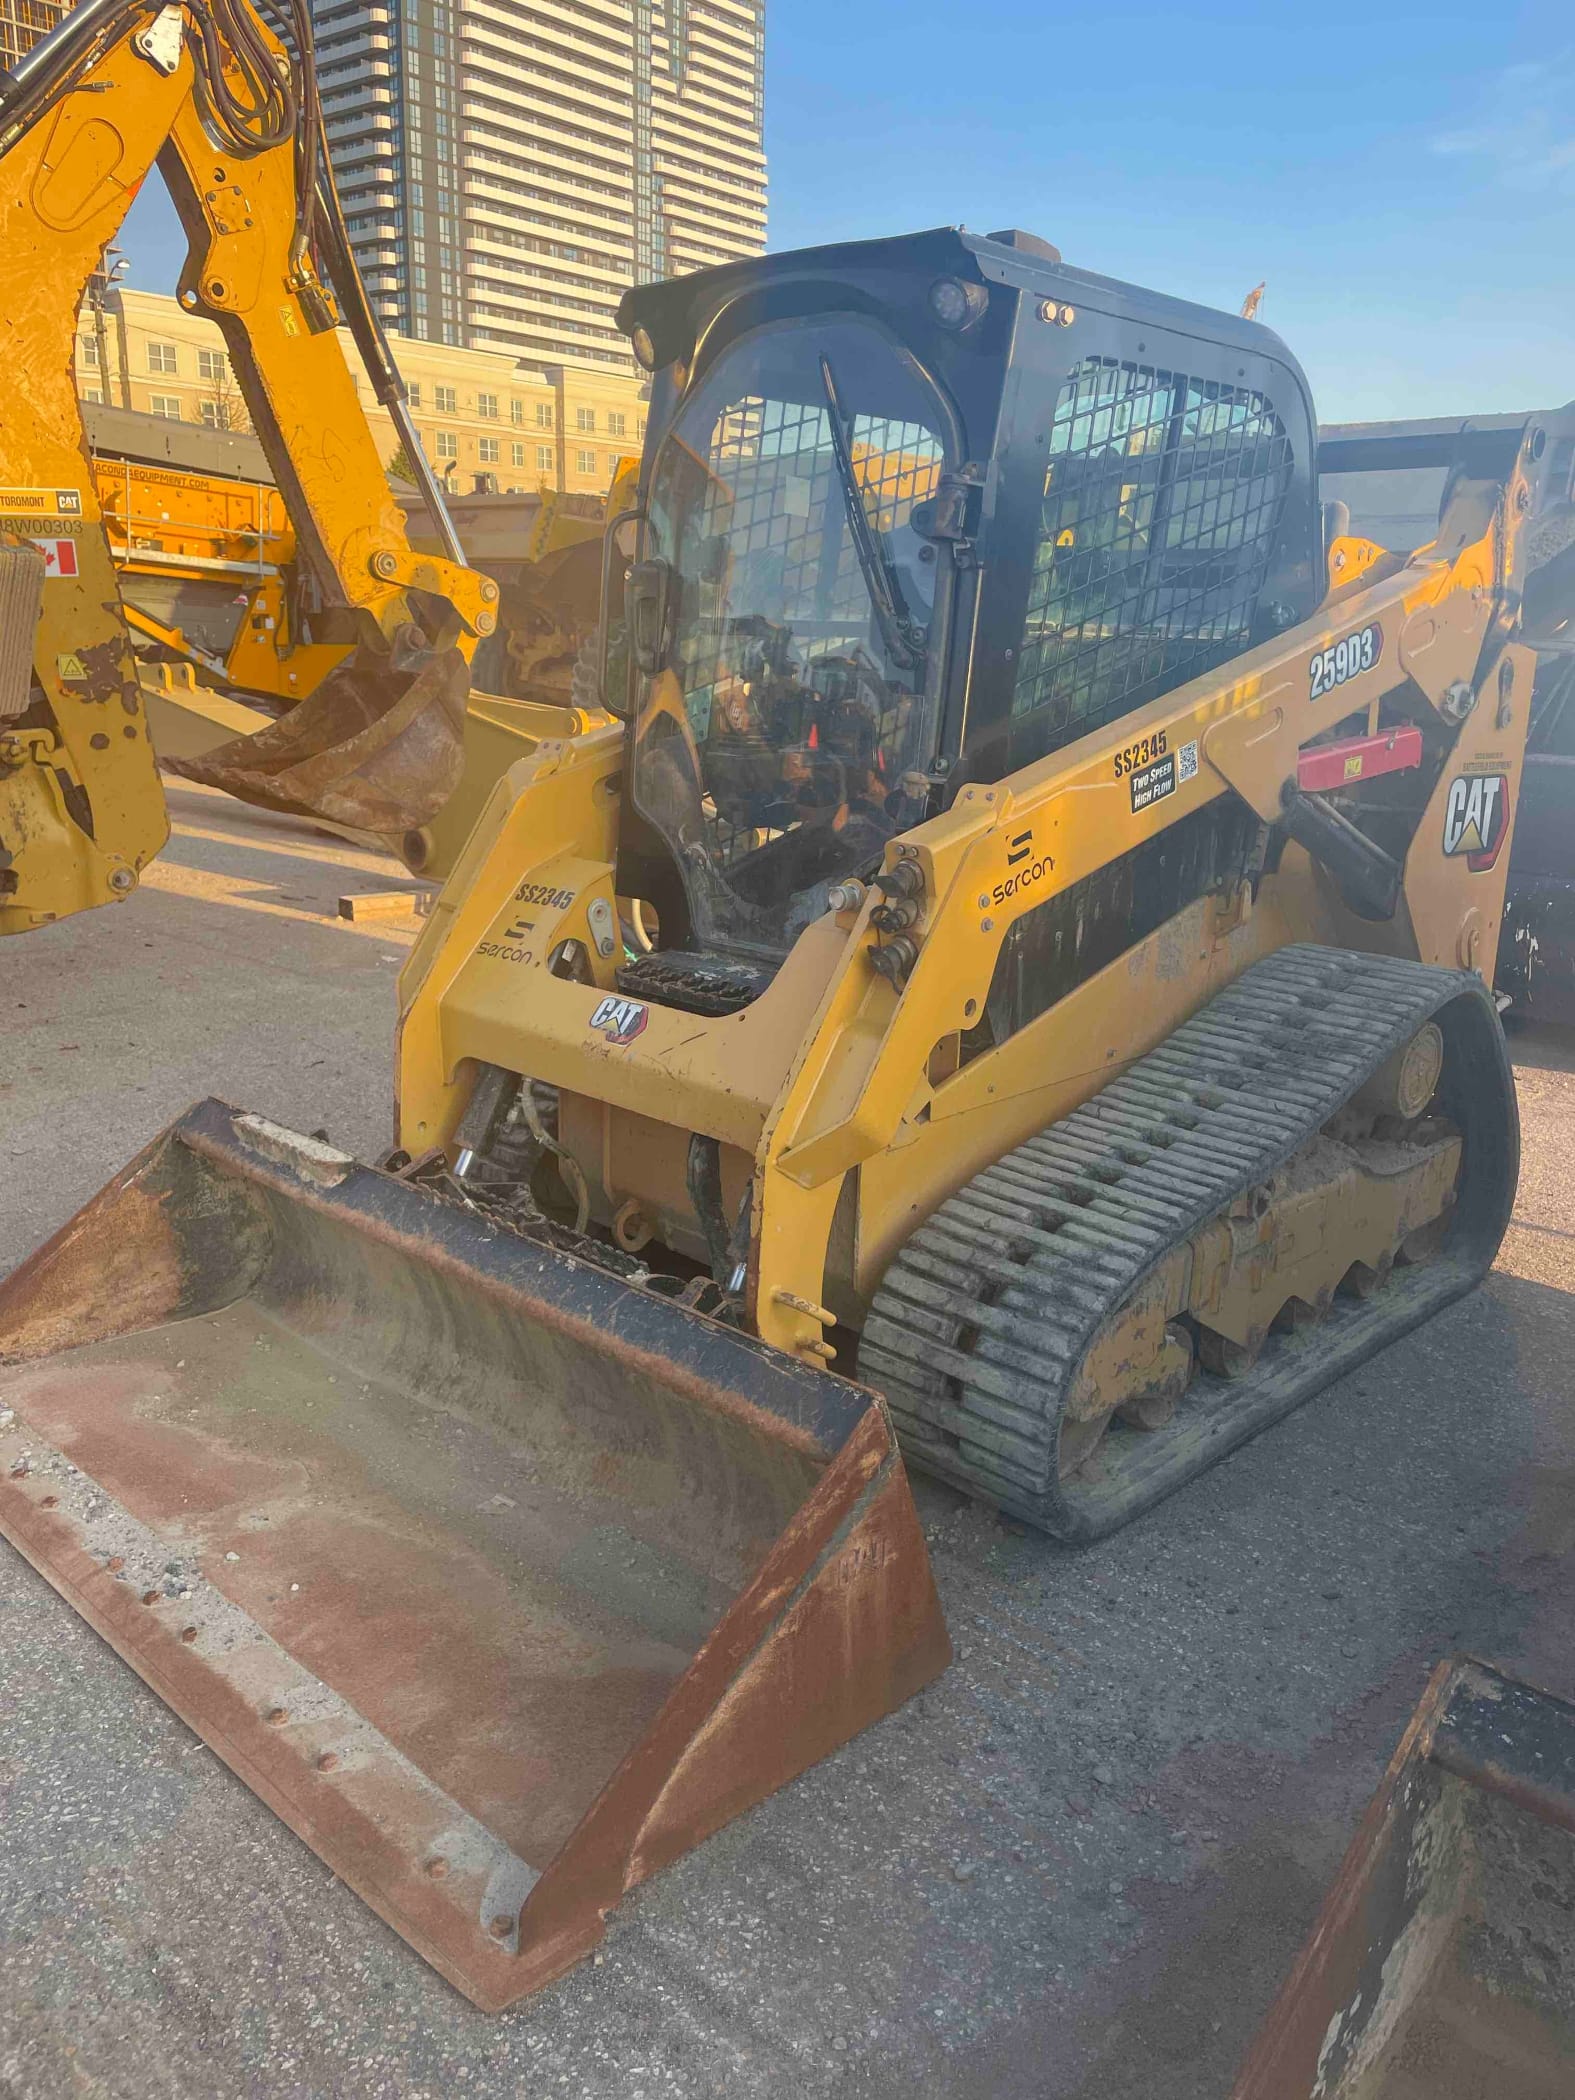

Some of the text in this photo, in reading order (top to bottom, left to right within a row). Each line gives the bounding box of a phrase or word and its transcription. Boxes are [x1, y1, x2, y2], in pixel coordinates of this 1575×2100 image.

[0, 496, 45, 507] TOROMONT
[58, 496, 78, 508] CAT
[1310, 628, 1374, 699] 259D3
[1114, 730, 1167, 778] SS2345
[1133, 762, 1172, 792] TWO SPEED
[1134, 778, 1172, 809] HIGH FLOW
[1443, 777, 1500, 854] CAT
[992, 856, 1054, 905] sercon
[515, 883, 576, 910] SS2345
[477, 941, 533, 966] sercon
[590, 997, 644, 1035] CAT
